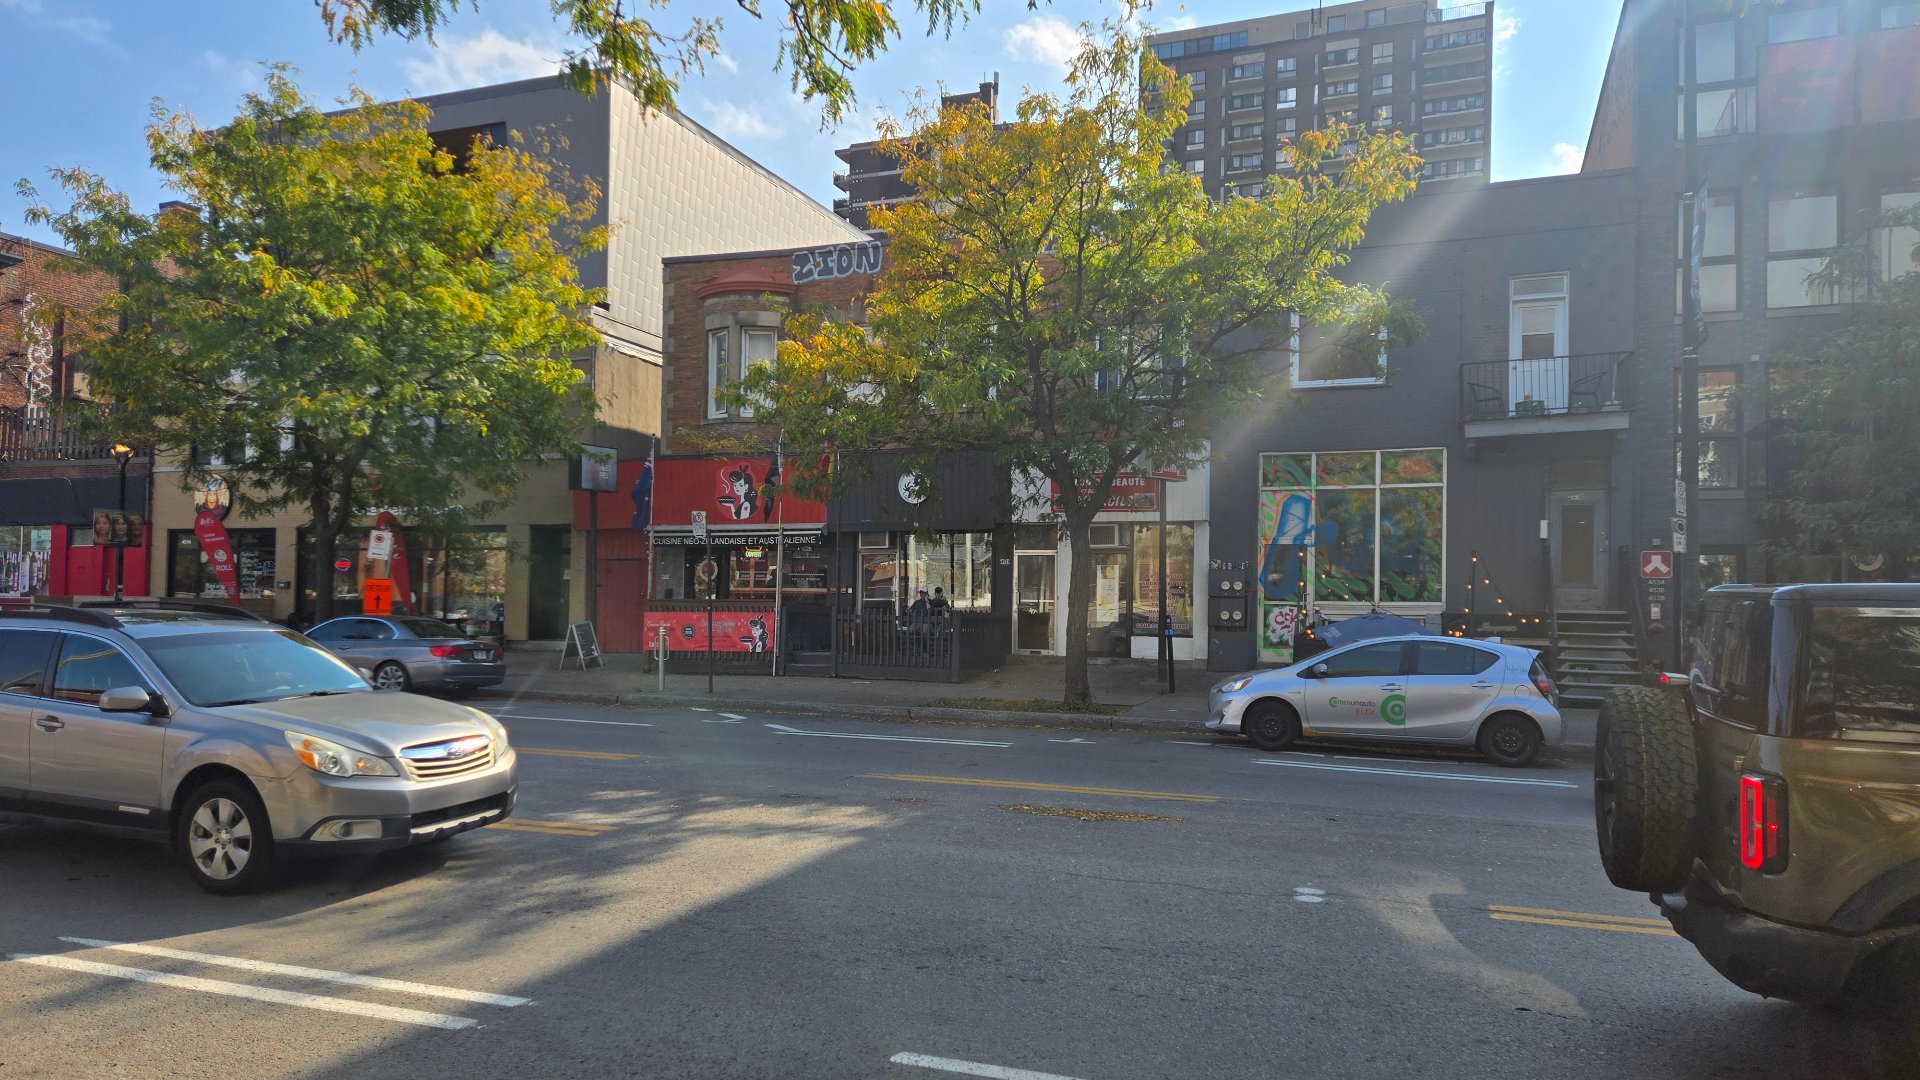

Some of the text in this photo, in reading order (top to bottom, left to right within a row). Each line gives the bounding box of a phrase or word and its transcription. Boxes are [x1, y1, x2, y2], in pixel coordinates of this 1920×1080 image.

[653, 536, 816, 545] CUISINE NÉO-ZLANDAISE ET AUSTALIENNE
[215, 564, 234, 572] ROLL
[1329, 696, 1376, 708] Communauto
